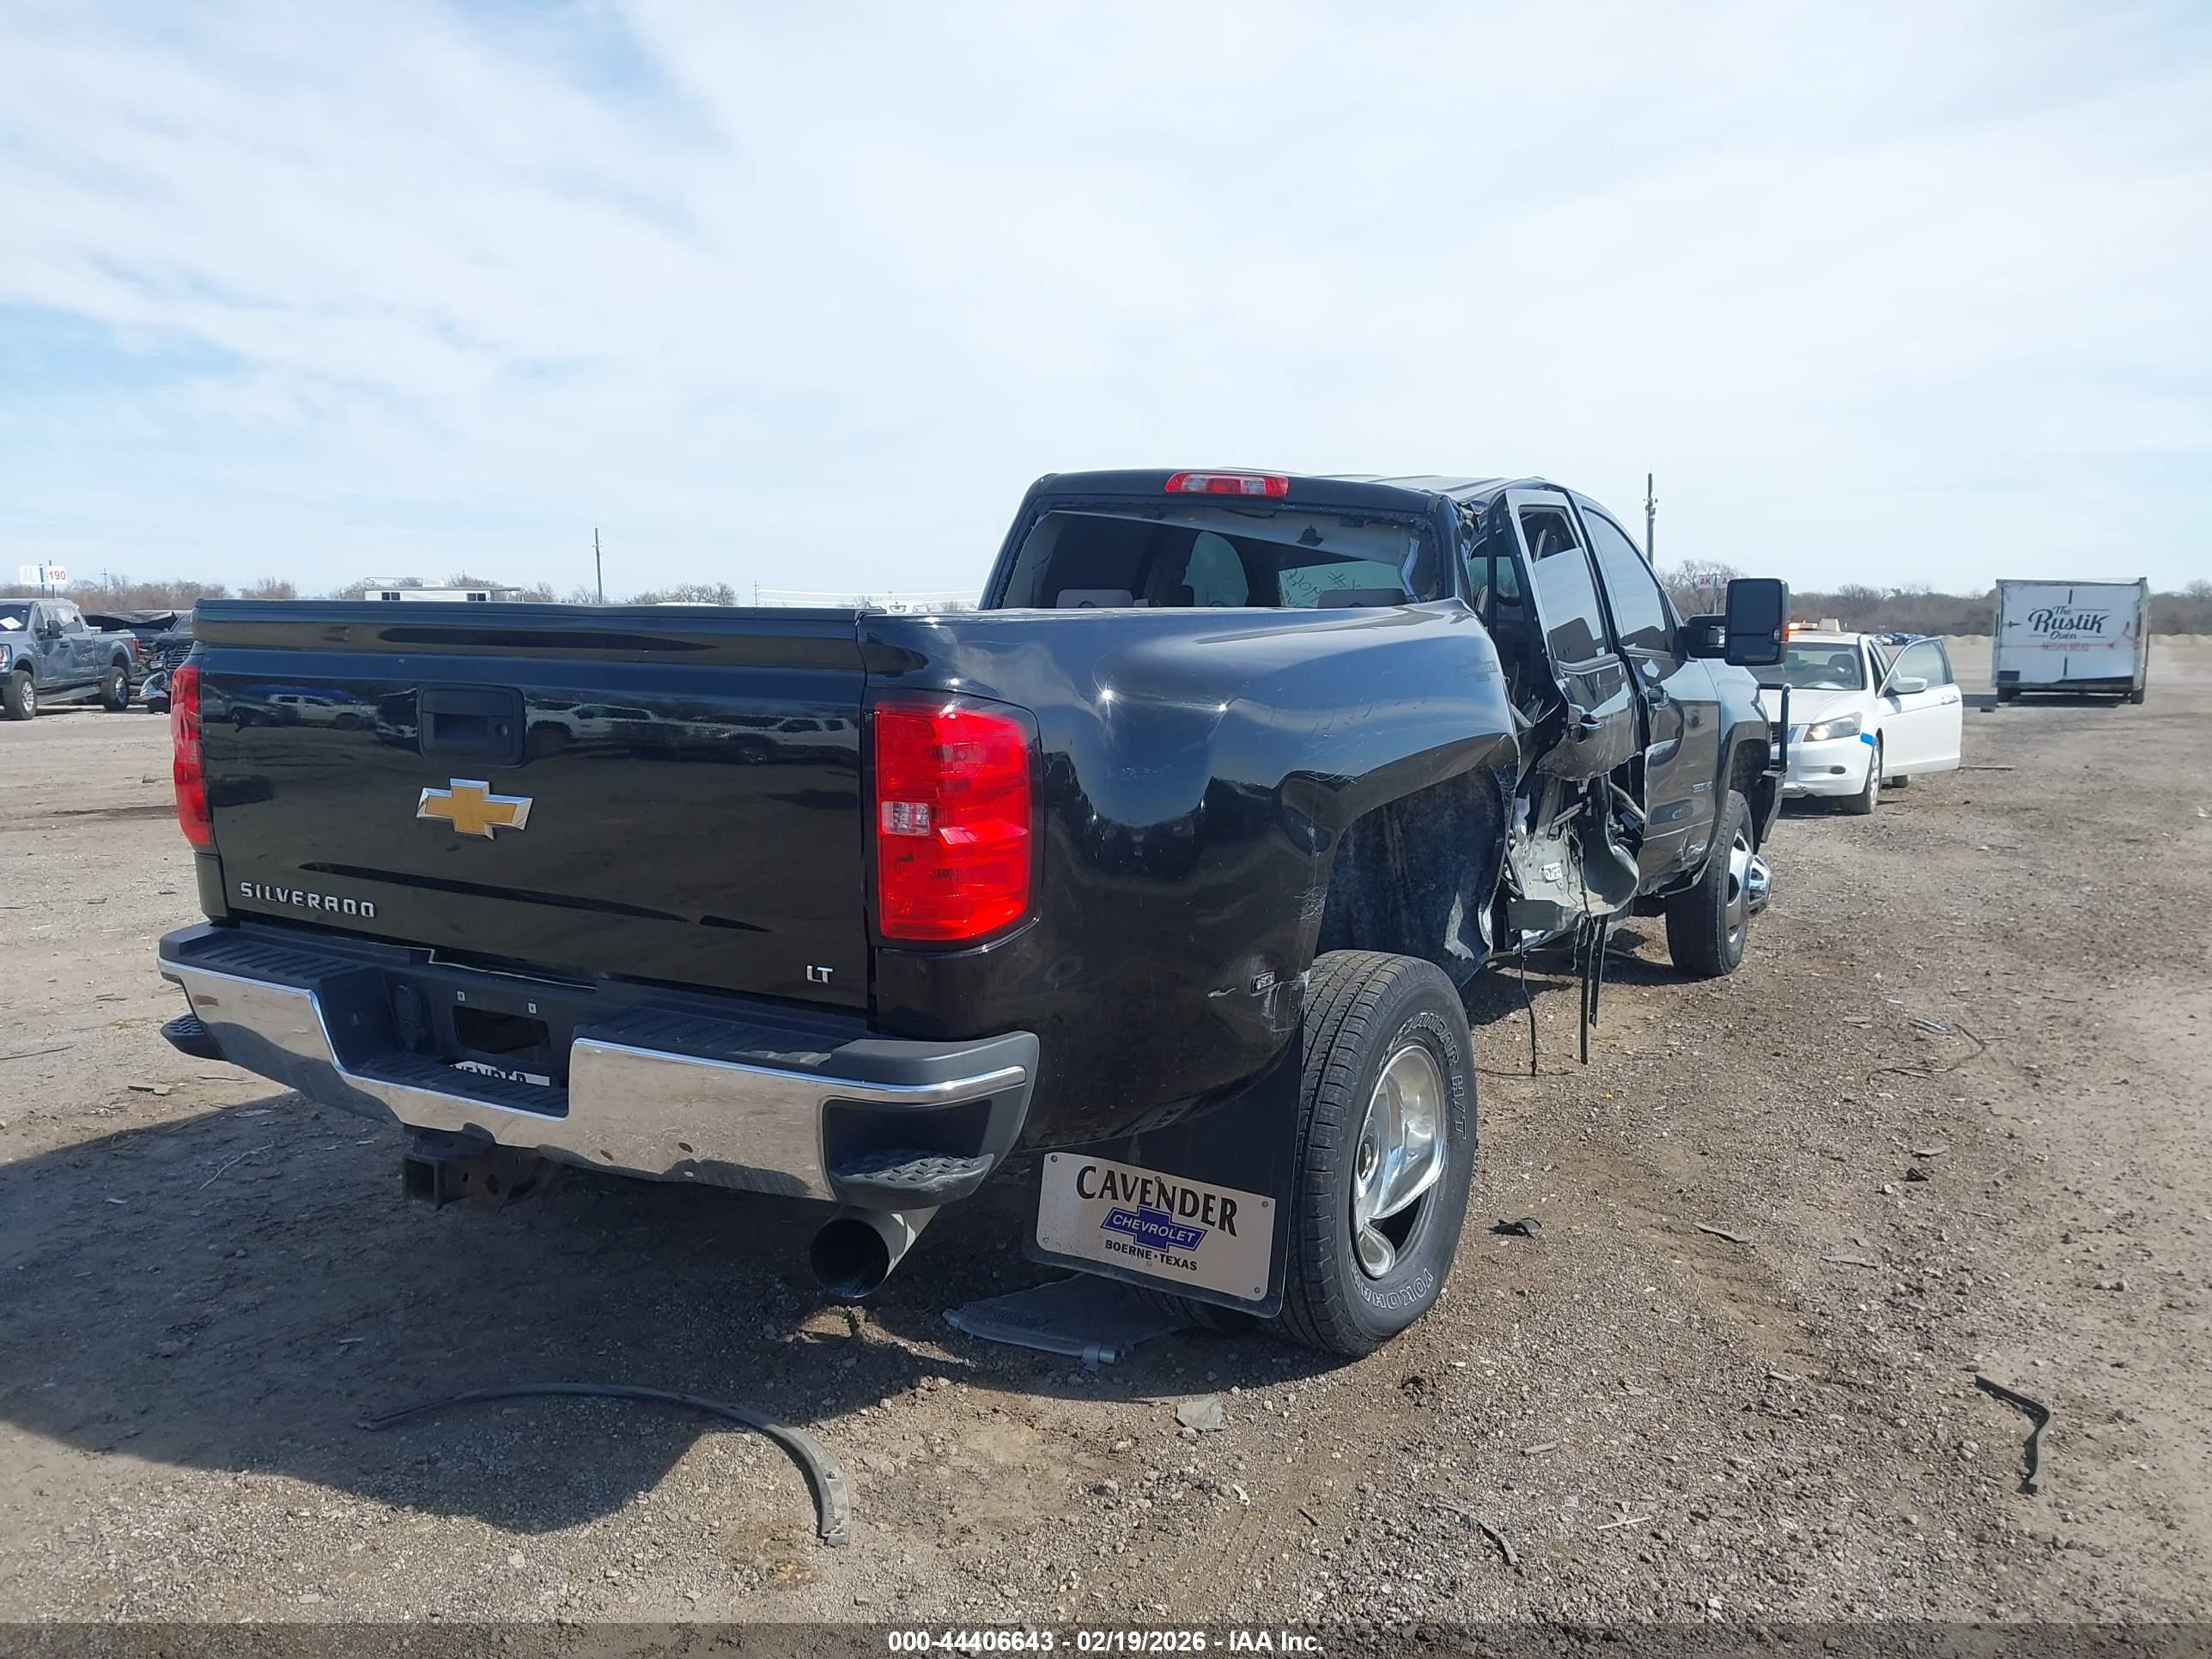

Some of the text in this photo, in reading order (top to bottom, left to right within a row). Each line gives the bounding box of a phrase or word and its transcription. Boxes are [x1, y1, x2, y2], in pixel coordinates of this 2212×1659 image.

[49, 571, 66, 580] 190
[2027, 608, 2110, 634] Rustik
[2052, 605, 2071, 615] The
[2050, 630, 2077, 640] Oven
[240, 882, 375, 918] SILVERADO
[806, 965, 834, 984] LT
[1451, 1075, 1467, 1140] H/T
[1076, 1165, 1237, 1237] CAVENDER
[1113, 1214, 1196, 1243] CHEVROLET
[1346, 1239, 1434, 1310] YOKOHAMA
